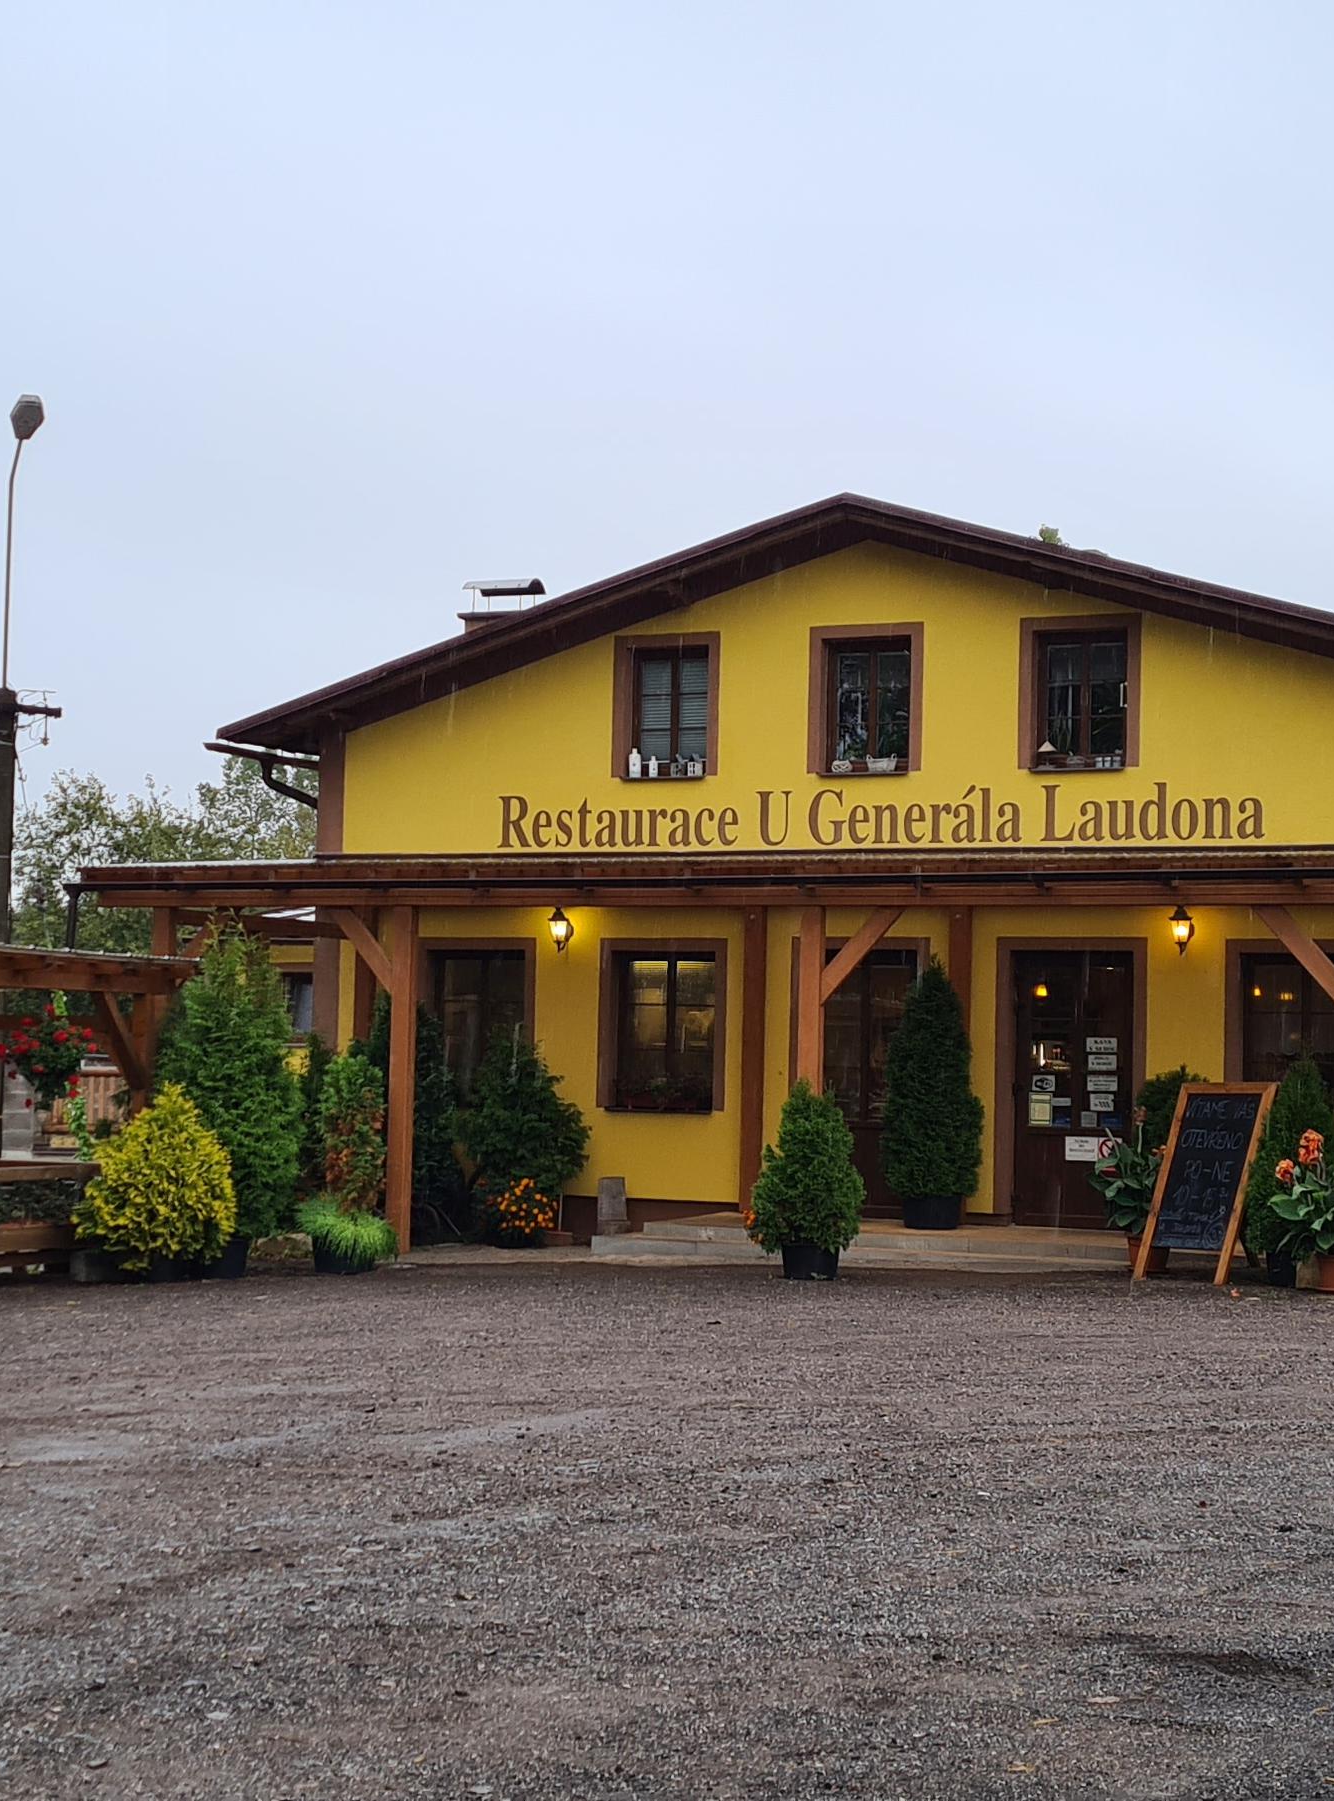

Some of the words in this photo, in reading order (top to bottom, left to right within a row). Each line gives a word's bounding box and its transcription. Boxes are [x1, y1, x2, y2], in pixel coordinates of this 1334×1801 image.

[497, 796, 739, 848] Restaurace
[755, 790, 793, 846] U
[808, 784, 1022, 846] Generála
[1040, 781, 1266, 842] Laudona
